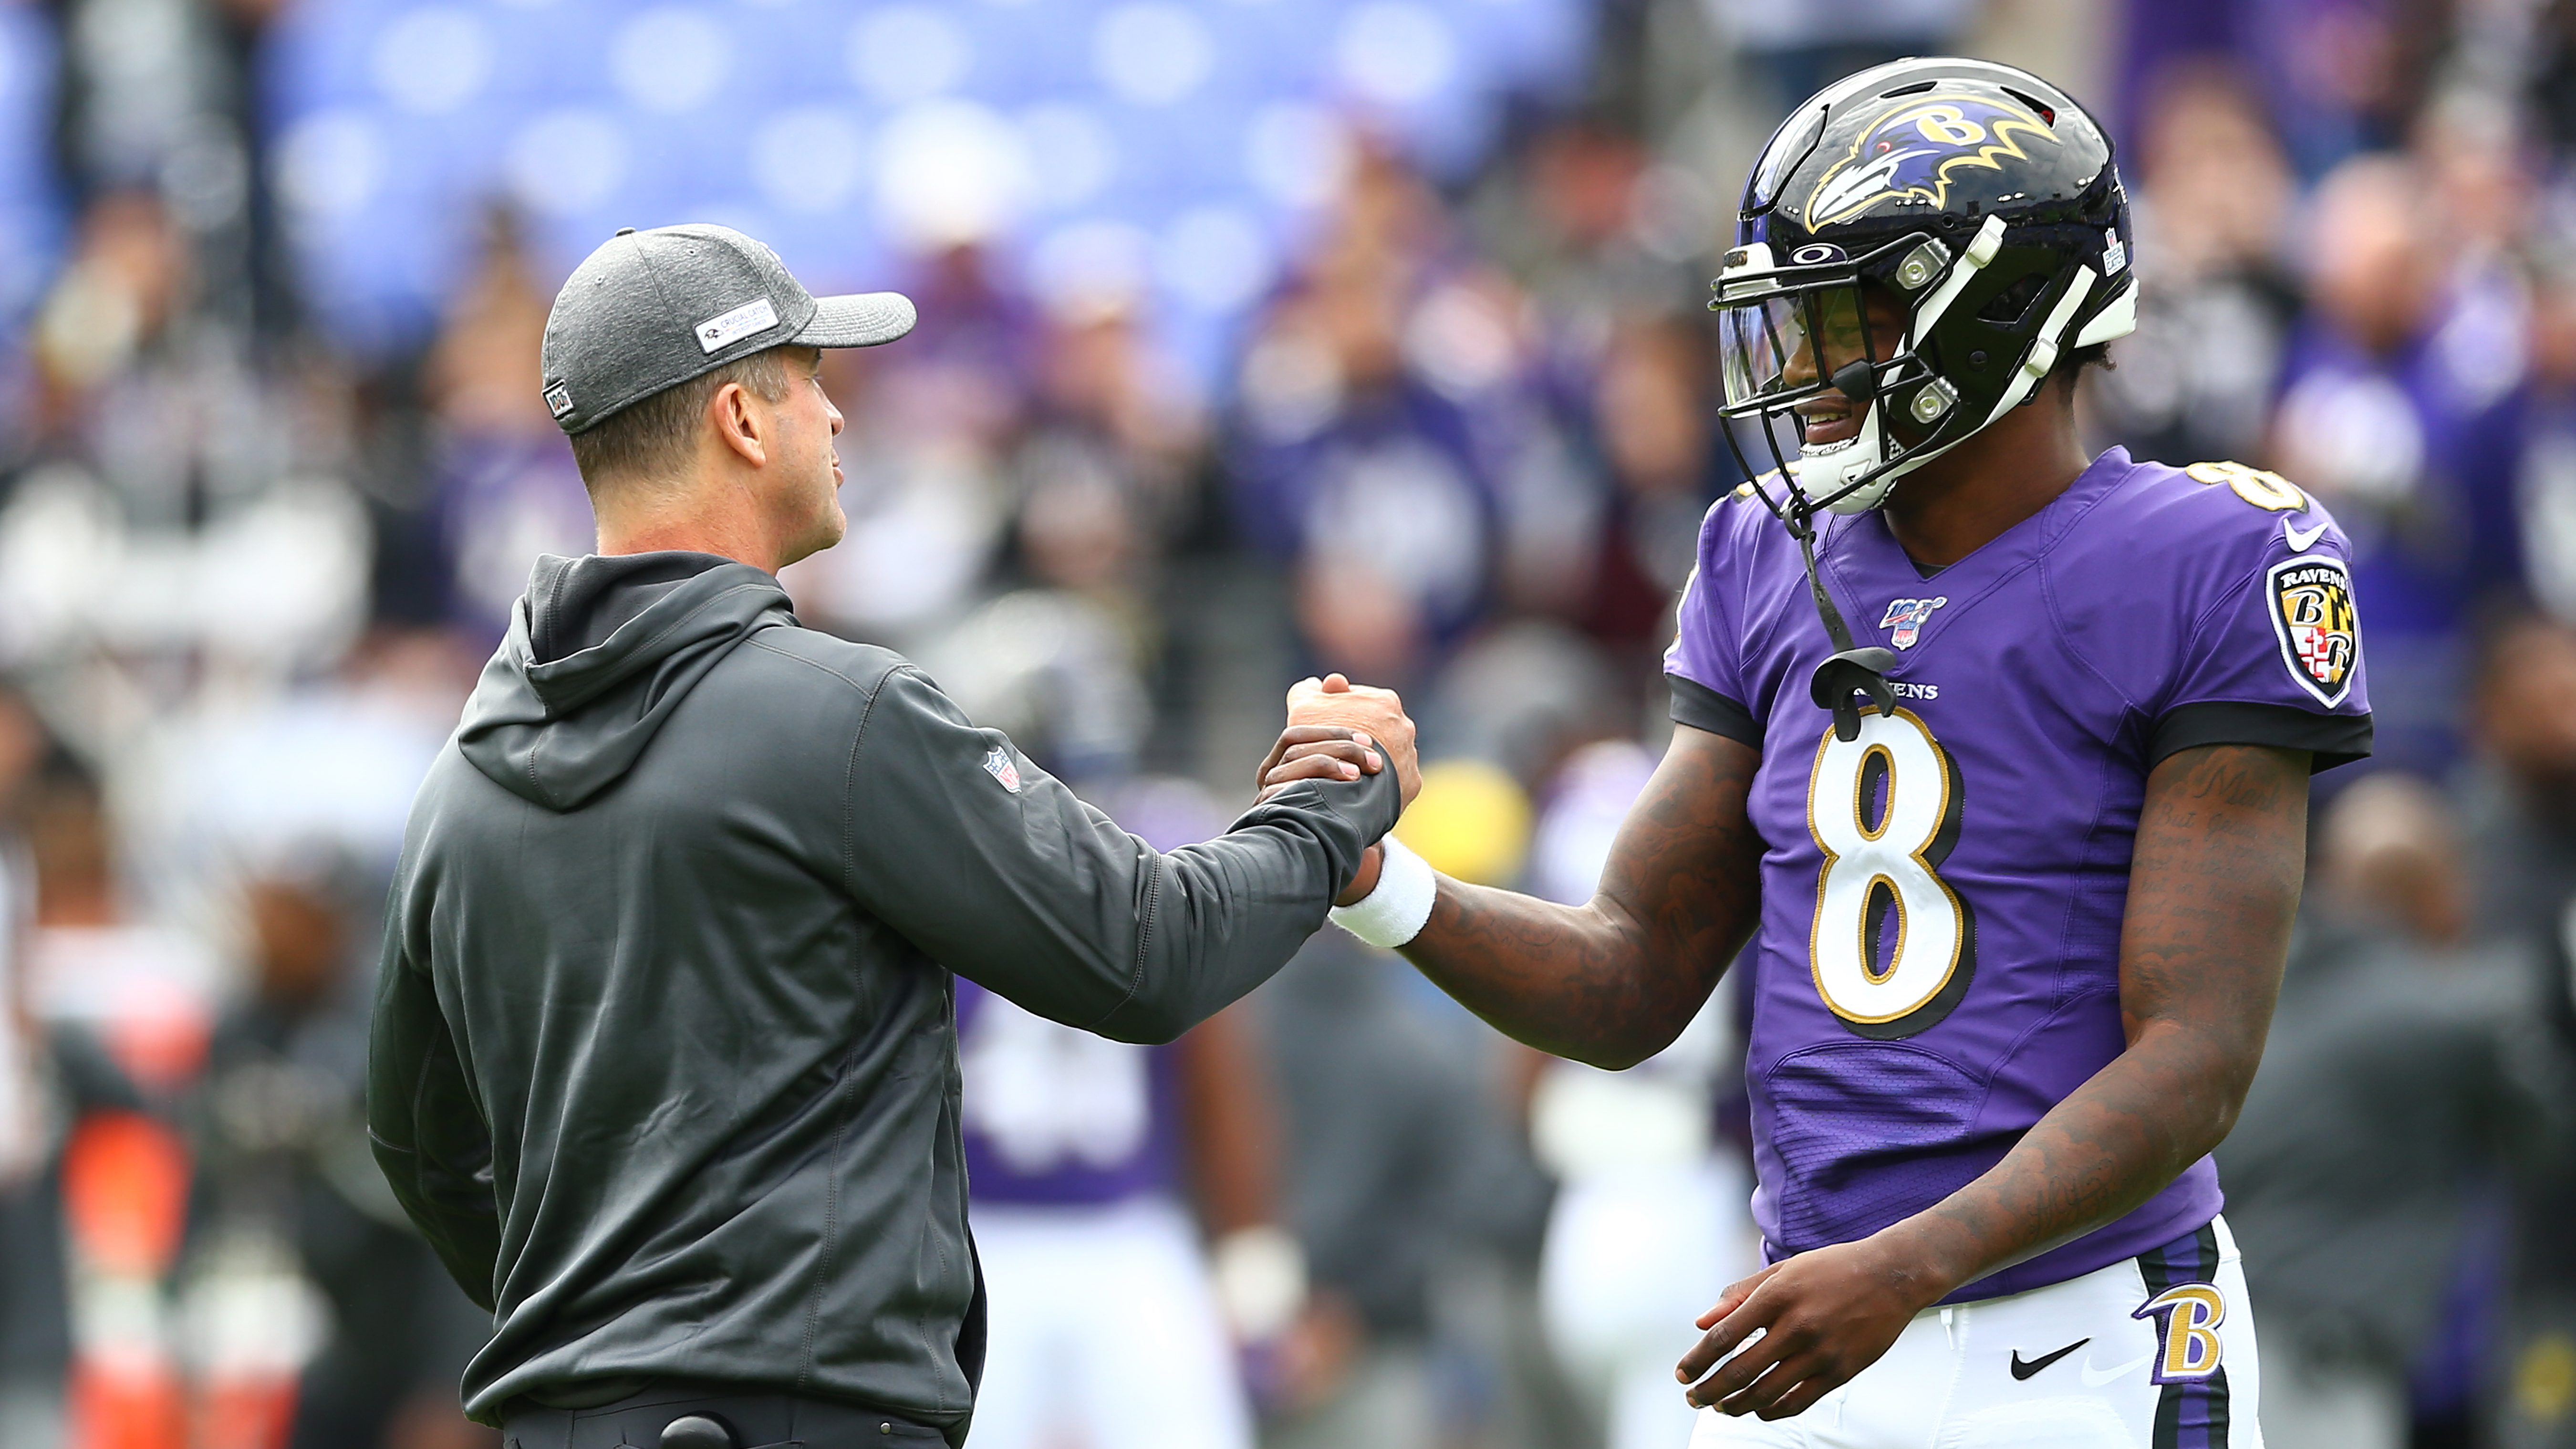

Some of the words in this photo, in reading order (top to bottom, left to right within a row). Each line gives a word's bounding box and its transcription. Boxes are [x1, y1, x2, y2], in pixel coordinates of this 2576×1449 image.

[1878, 104, 1987, 146] B
[720, 312, 748, 328] CRUCIAL
[748, 304, 769, 317] CATCH
[2185, 461, 2308, 512] 8
[2281, 568, 2346, 591] RAVENS
[2282, 586, 2325, 626] B
[1807, 705, 1964, 1025] 8
[2131, 1282, 2226, 1384] B
